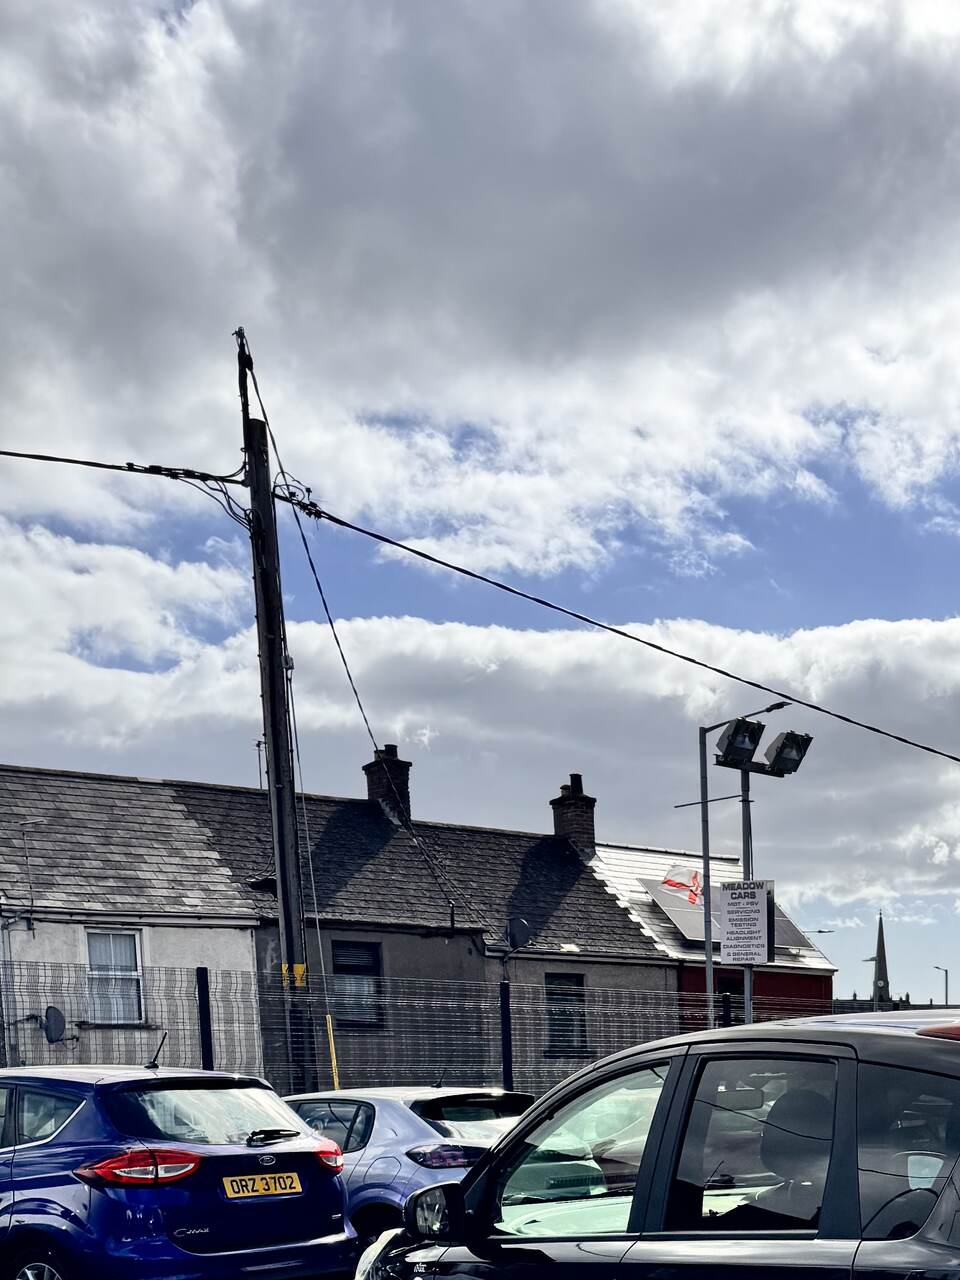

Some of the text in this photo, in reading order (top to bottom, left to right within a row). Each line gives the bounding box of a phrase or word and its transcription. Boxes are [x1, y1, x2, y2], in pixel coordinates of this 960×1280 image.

[723, 882, 764, 891] MEADOW
[731, 891, 757, 900] CARS
[230, 1176, 296, 1194] ORZ 3702
